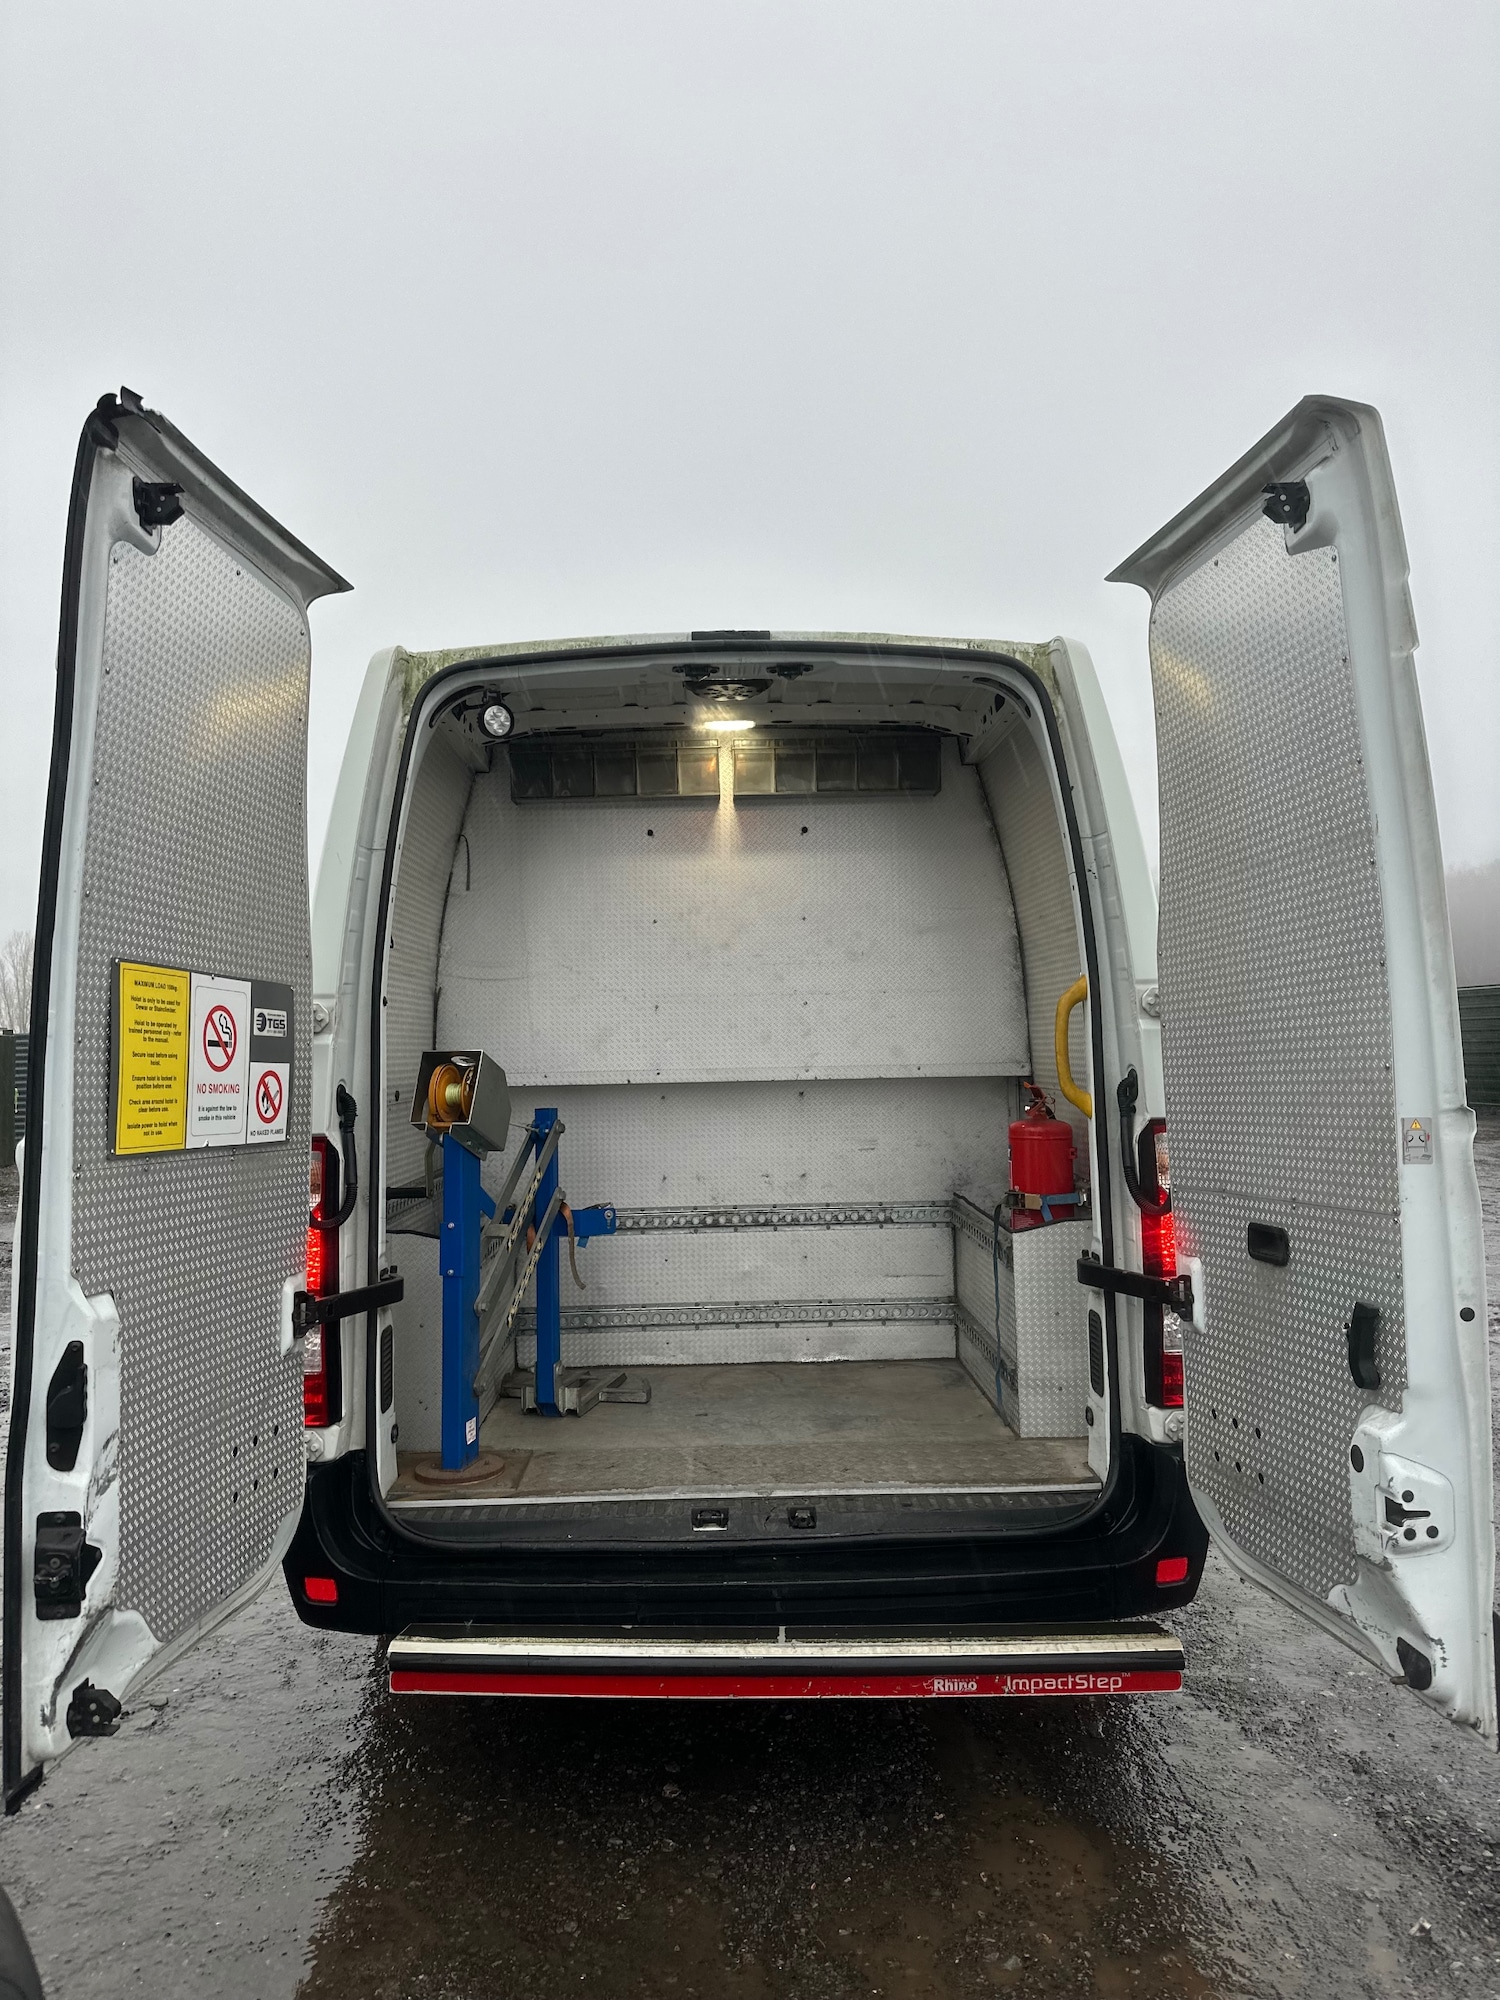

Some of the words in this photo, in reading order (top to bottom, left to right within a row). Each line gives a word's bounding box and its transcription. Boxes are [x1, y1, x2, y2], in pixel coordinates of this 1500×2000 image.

[134, 980, 154, 988] MAXIMUM
[267, 1019, 285, 1029] TGS
[197, 1083, 206, 1094] NO
[208, 1083, 240, 1094] SMOKING
[933, 1679, 977, 1691] Rhino
[1006, 1674, 1122, 1693] ImpactStep
